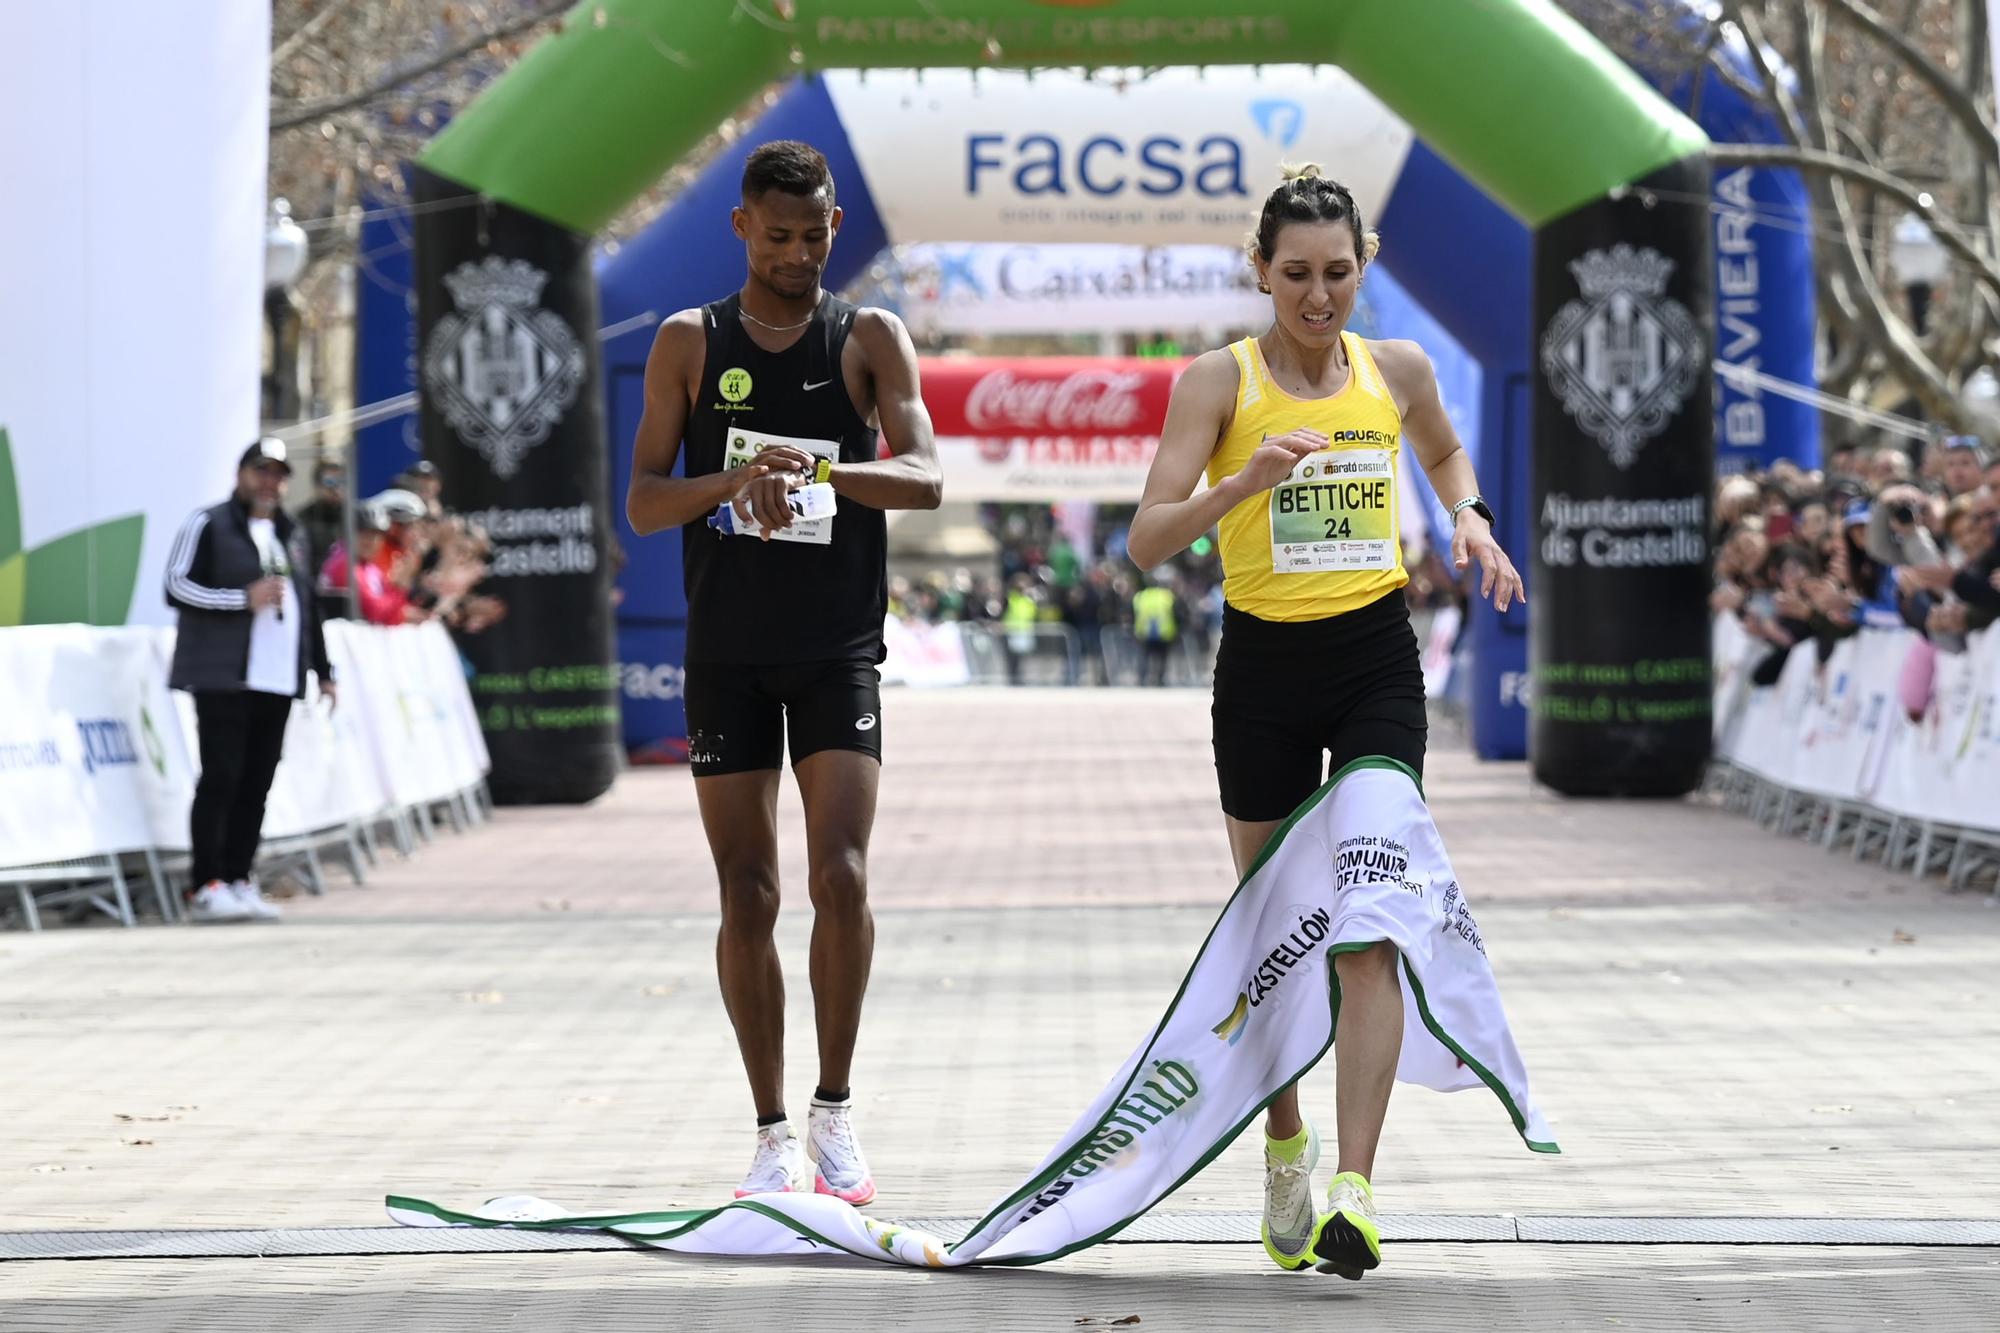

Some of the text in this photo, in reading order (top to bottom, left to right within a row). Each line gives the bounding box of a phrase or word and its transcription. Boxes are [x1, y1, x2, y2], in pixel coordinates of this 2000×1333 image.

[1334, 430, 1395, 445] AQUAGYM
[1280, 482, 1385, 514] BETTICHE
[1324, 517, 1351, 539] 24
[1542, 532, 1577, 566] de
[1336, 835, 1377, 852] Comunitat
[1248, 907, 1330, 1007] CASTELLÓN
